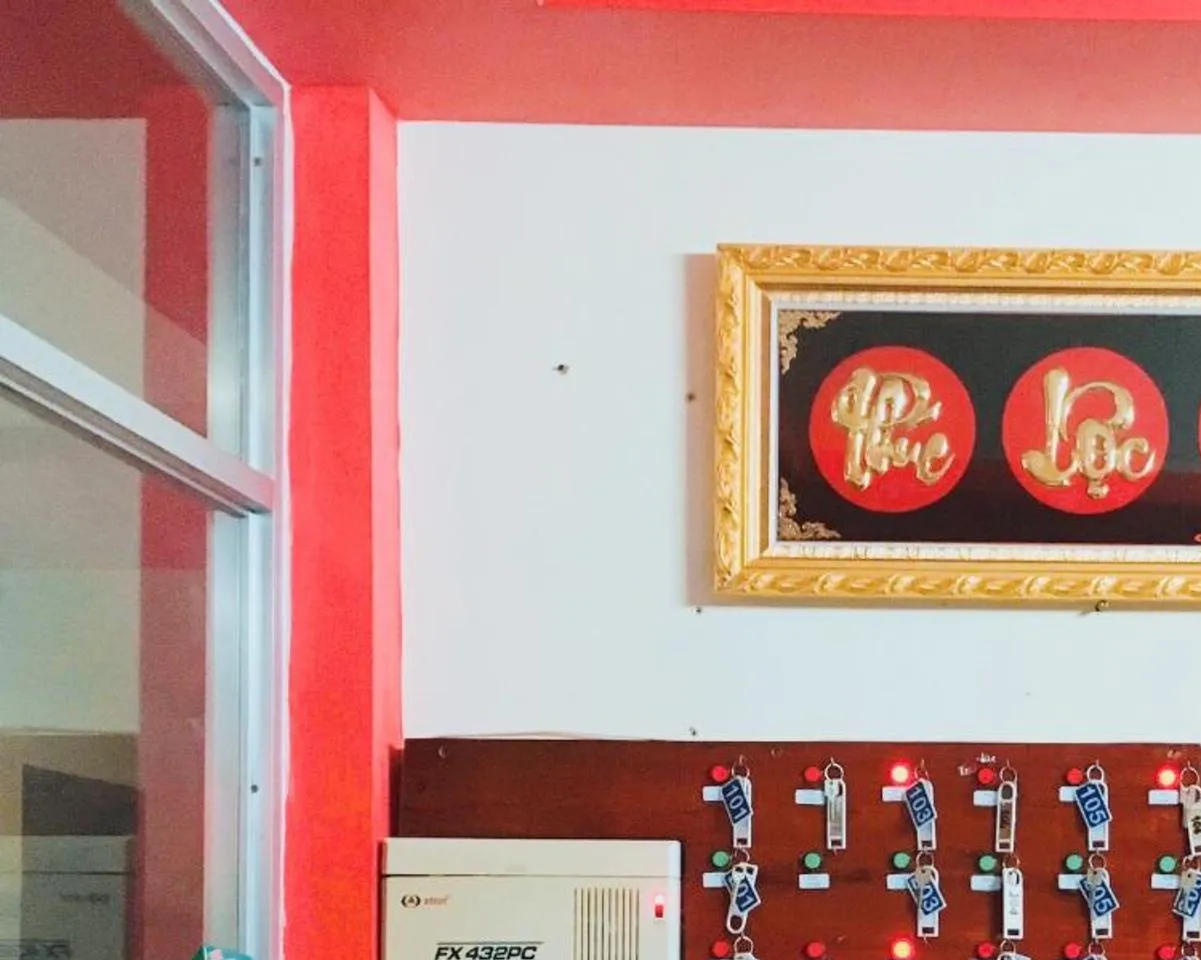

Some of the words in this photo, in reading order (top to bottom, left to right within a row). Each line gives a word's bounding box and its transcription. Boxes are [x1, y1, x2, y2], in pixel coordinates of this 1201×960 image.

[726, 784, 748, 823] 101
[908, 785, 933, 826] 103
[1079, 786, 1107, 825] 105
[434, 946, 463, 960] FX
[465, 946, 538, 960] 432PC
